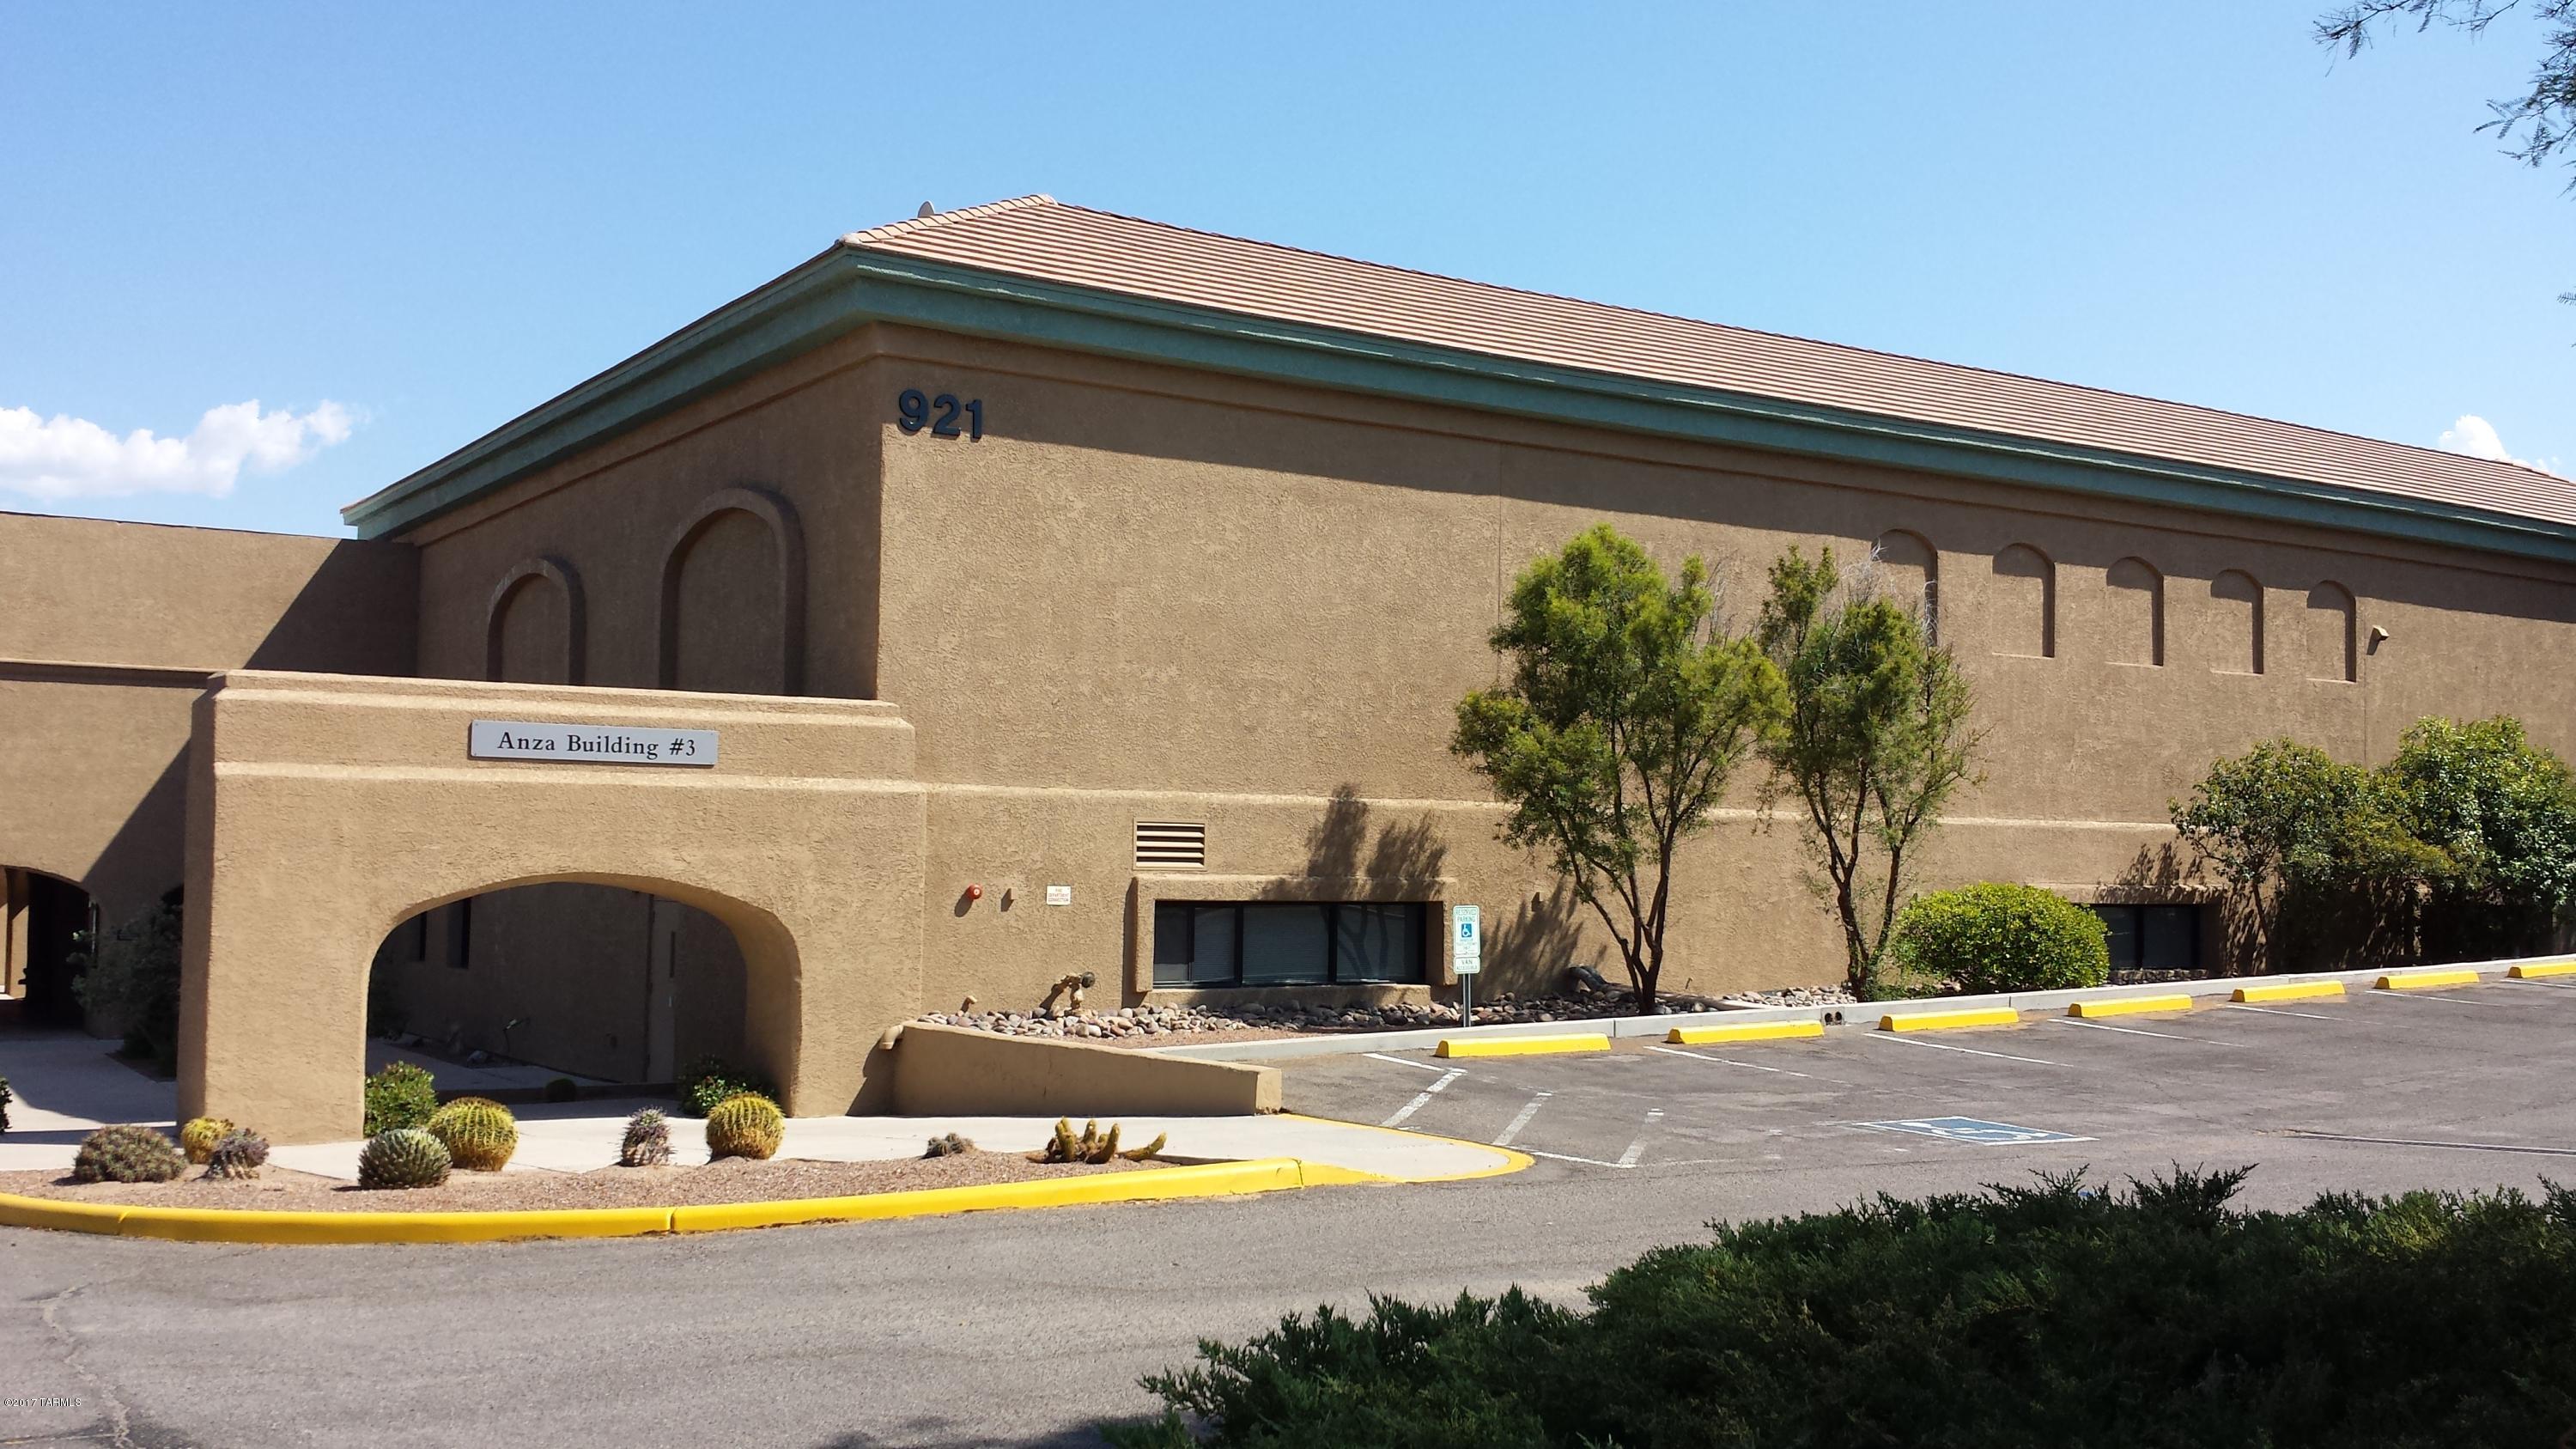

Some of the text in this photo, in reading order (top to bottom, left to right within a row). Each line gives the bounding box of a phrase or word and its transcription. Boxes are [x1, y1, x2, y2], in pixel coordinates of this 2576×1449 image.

[898, 389, 982, 440] 921
[497, 732, 696, 759] Anza Building #3
